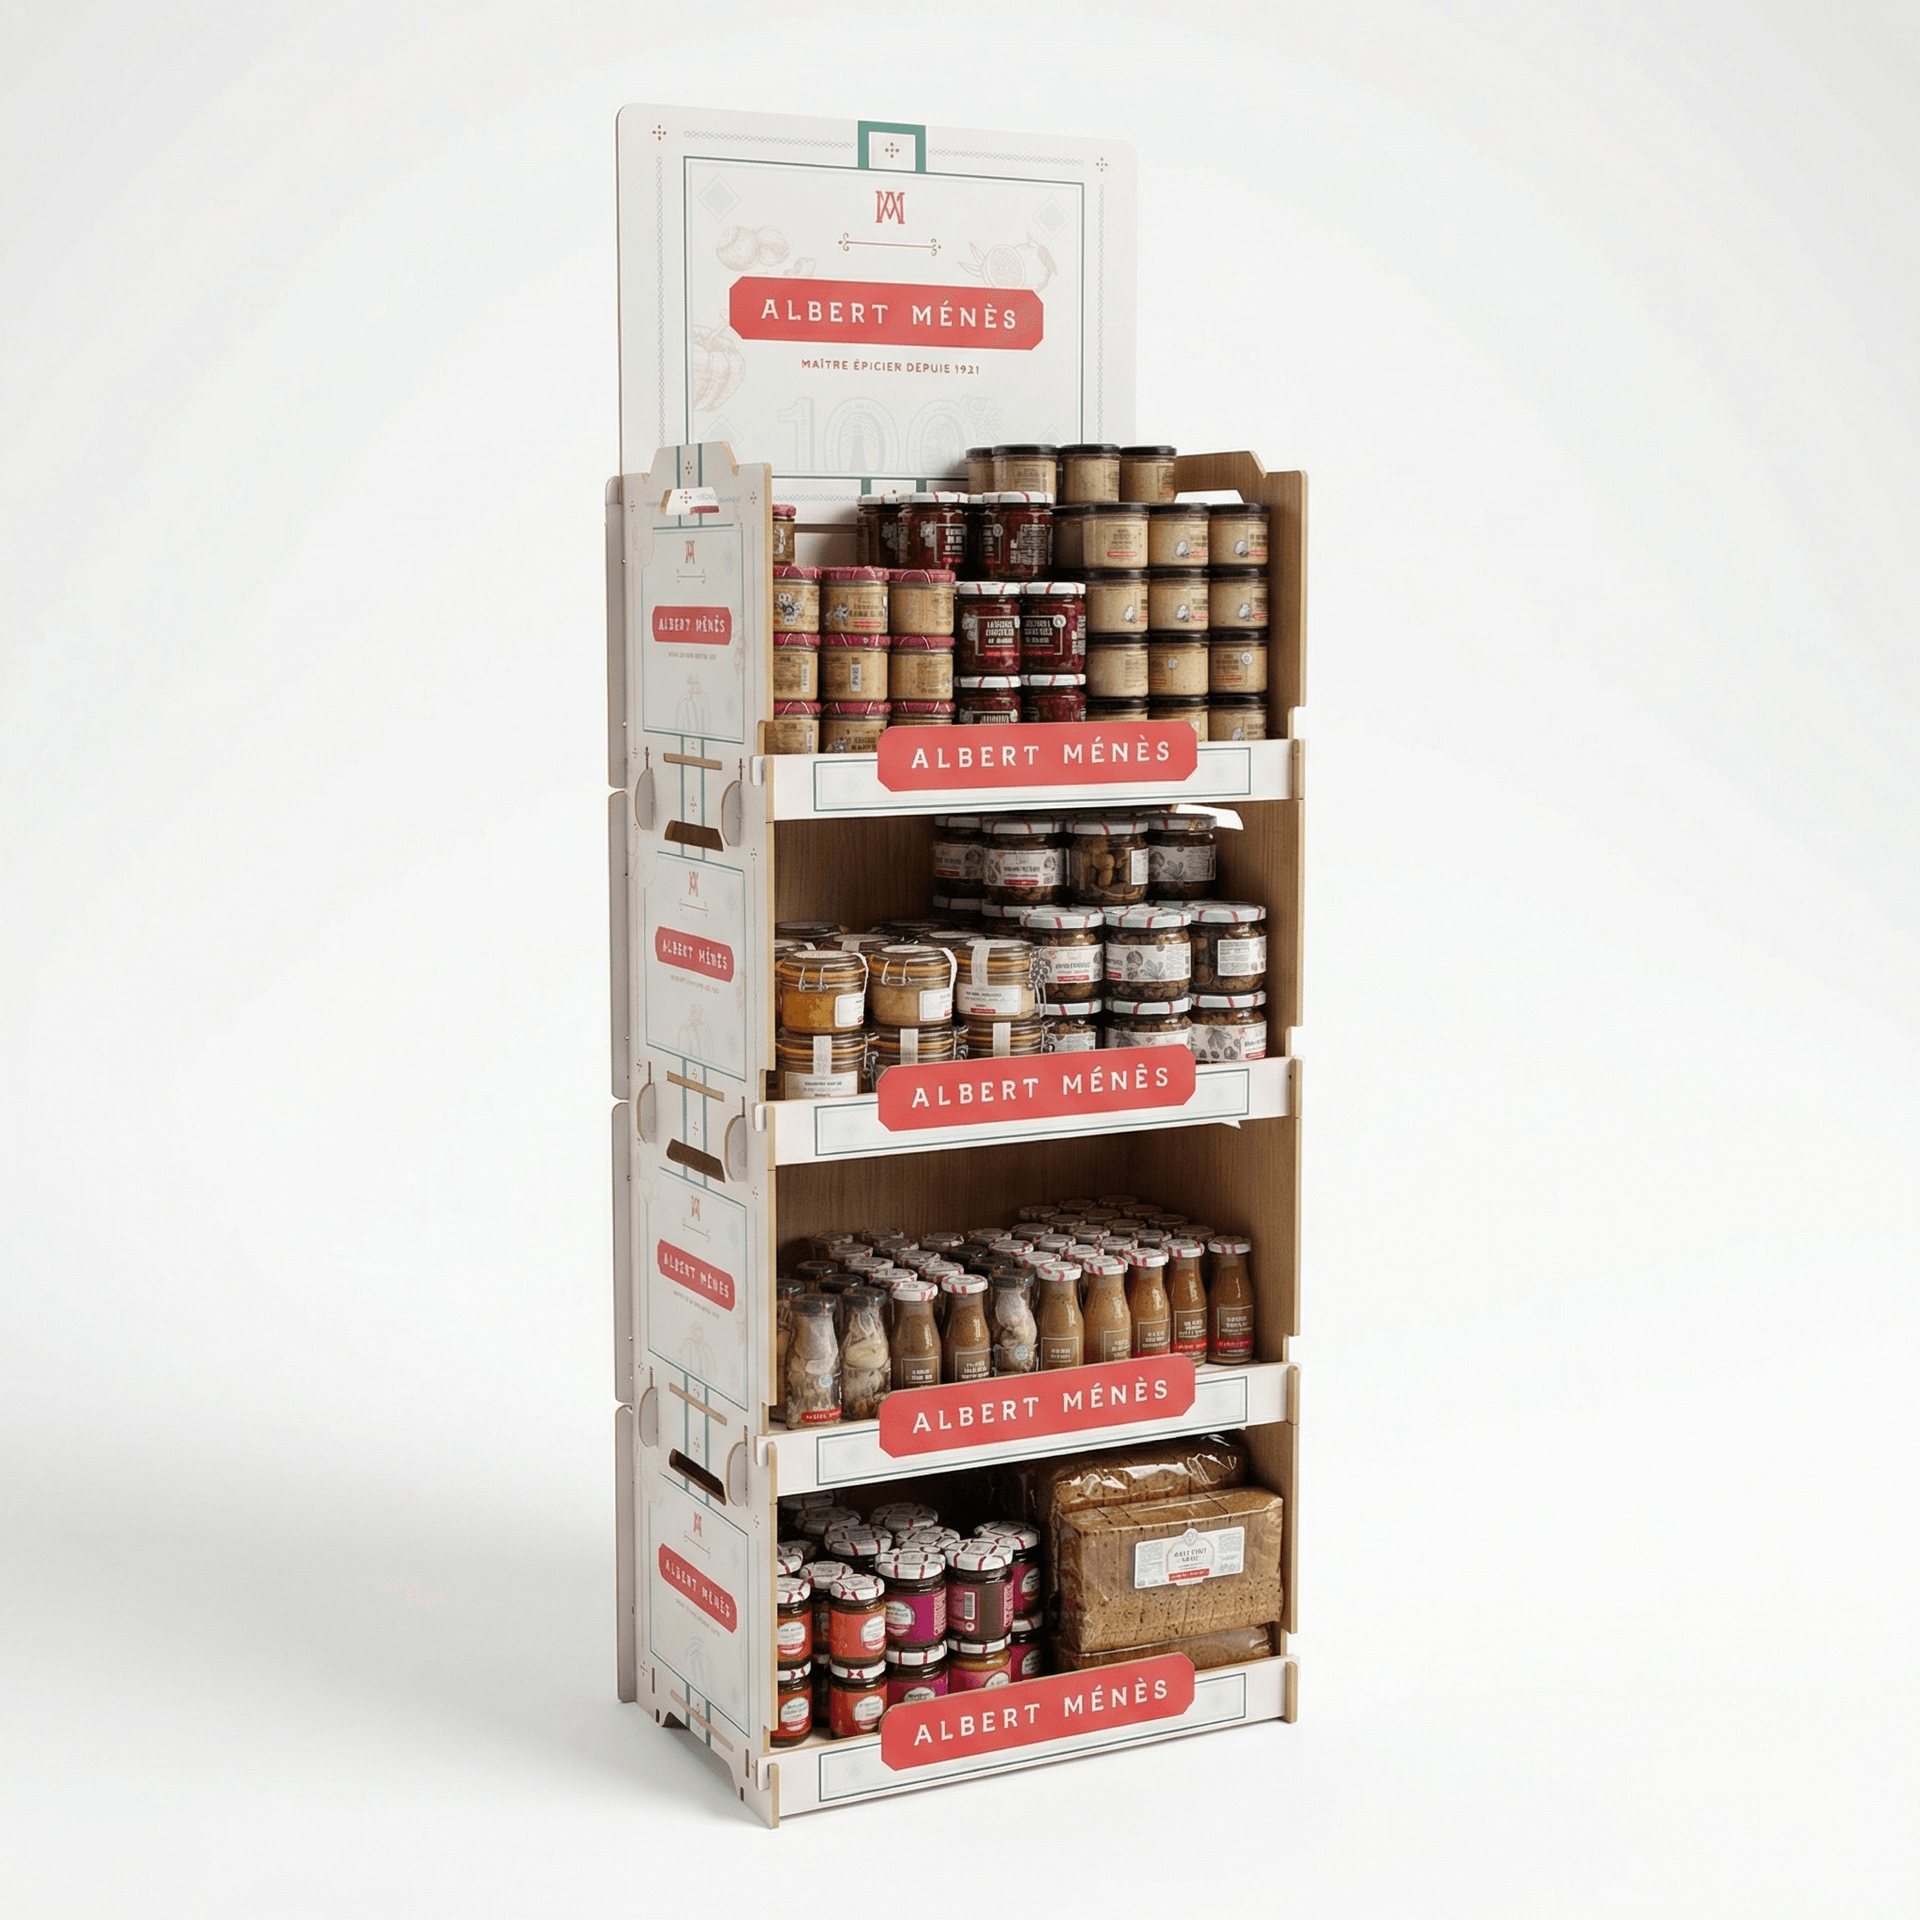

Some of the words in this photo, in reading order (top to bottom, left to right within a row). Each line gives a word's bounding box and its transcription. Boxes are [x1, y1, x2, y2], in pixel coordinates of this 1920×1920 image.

[761, 298, 889, 324] ALBERT
[911, 299, 1016, 330] MÉNÈS
[801, 358, 848, 370] MAÎTRE
[853, 359, 902, 372] ÉPICIER
[911, 745, 1039, 769] ALBERT
[1063, 734, 1169, 764] MÉNÈS
[911, 1077, 1039, 1108] ALBERT
[912, 1396, 1039, 1434] ALBERT
[1062, 1376, 1168, 1413] MÉNÈS
[913, 1703, 1040, 1746] ALBERT
[1064, 1677, 1167, 1717] MÉNÈS
